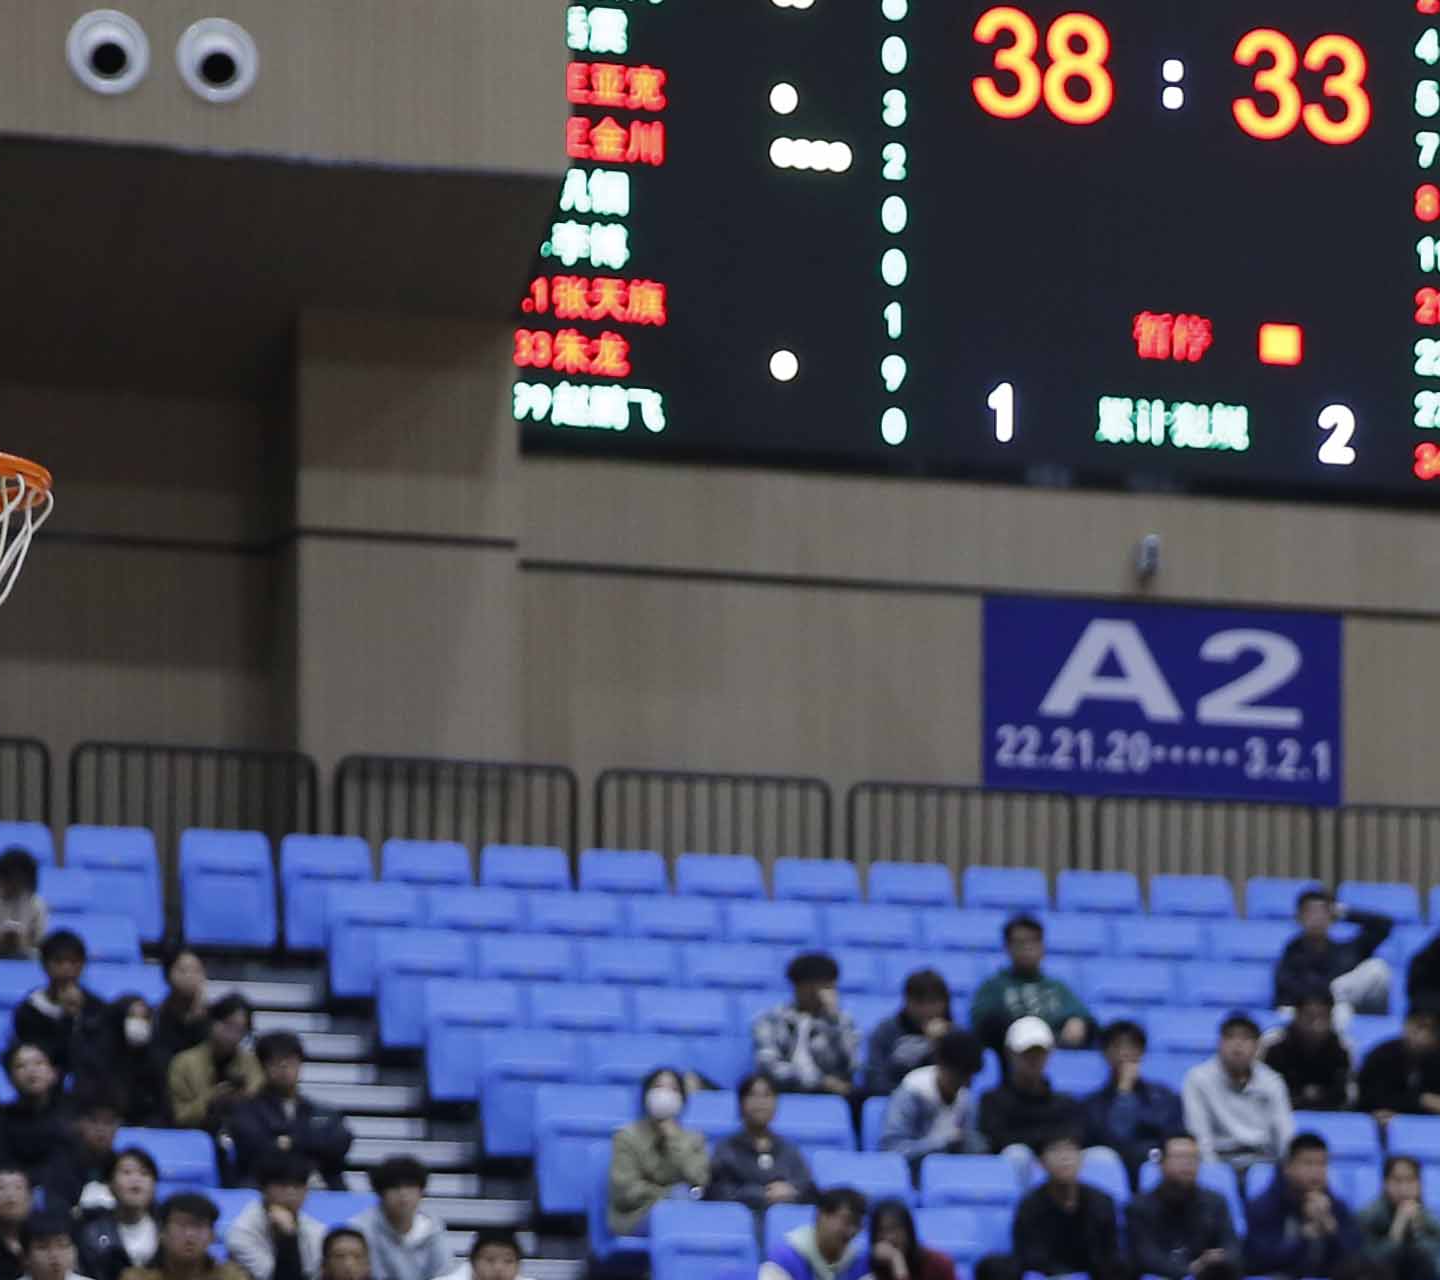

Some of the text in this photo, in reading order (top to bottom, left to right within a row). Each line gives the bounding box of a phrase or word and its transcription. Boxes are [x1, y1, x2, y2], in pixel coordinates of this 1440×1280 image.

[972, 6, 1114, 125] 38
[1232, 28, 1373, 145] 33
[1415, 29, 1440, 64] 4
[883, 143, 906, 180] 2
[1416, 132, 1440, 168] 7
[522, 277, 549, 313] 1
[884, 302, 902, 338] 1
[988, 383, 1013, 442] 1
[1318, 405, 1355, 464] 2
[1037, 617, 1304, 730] A2
